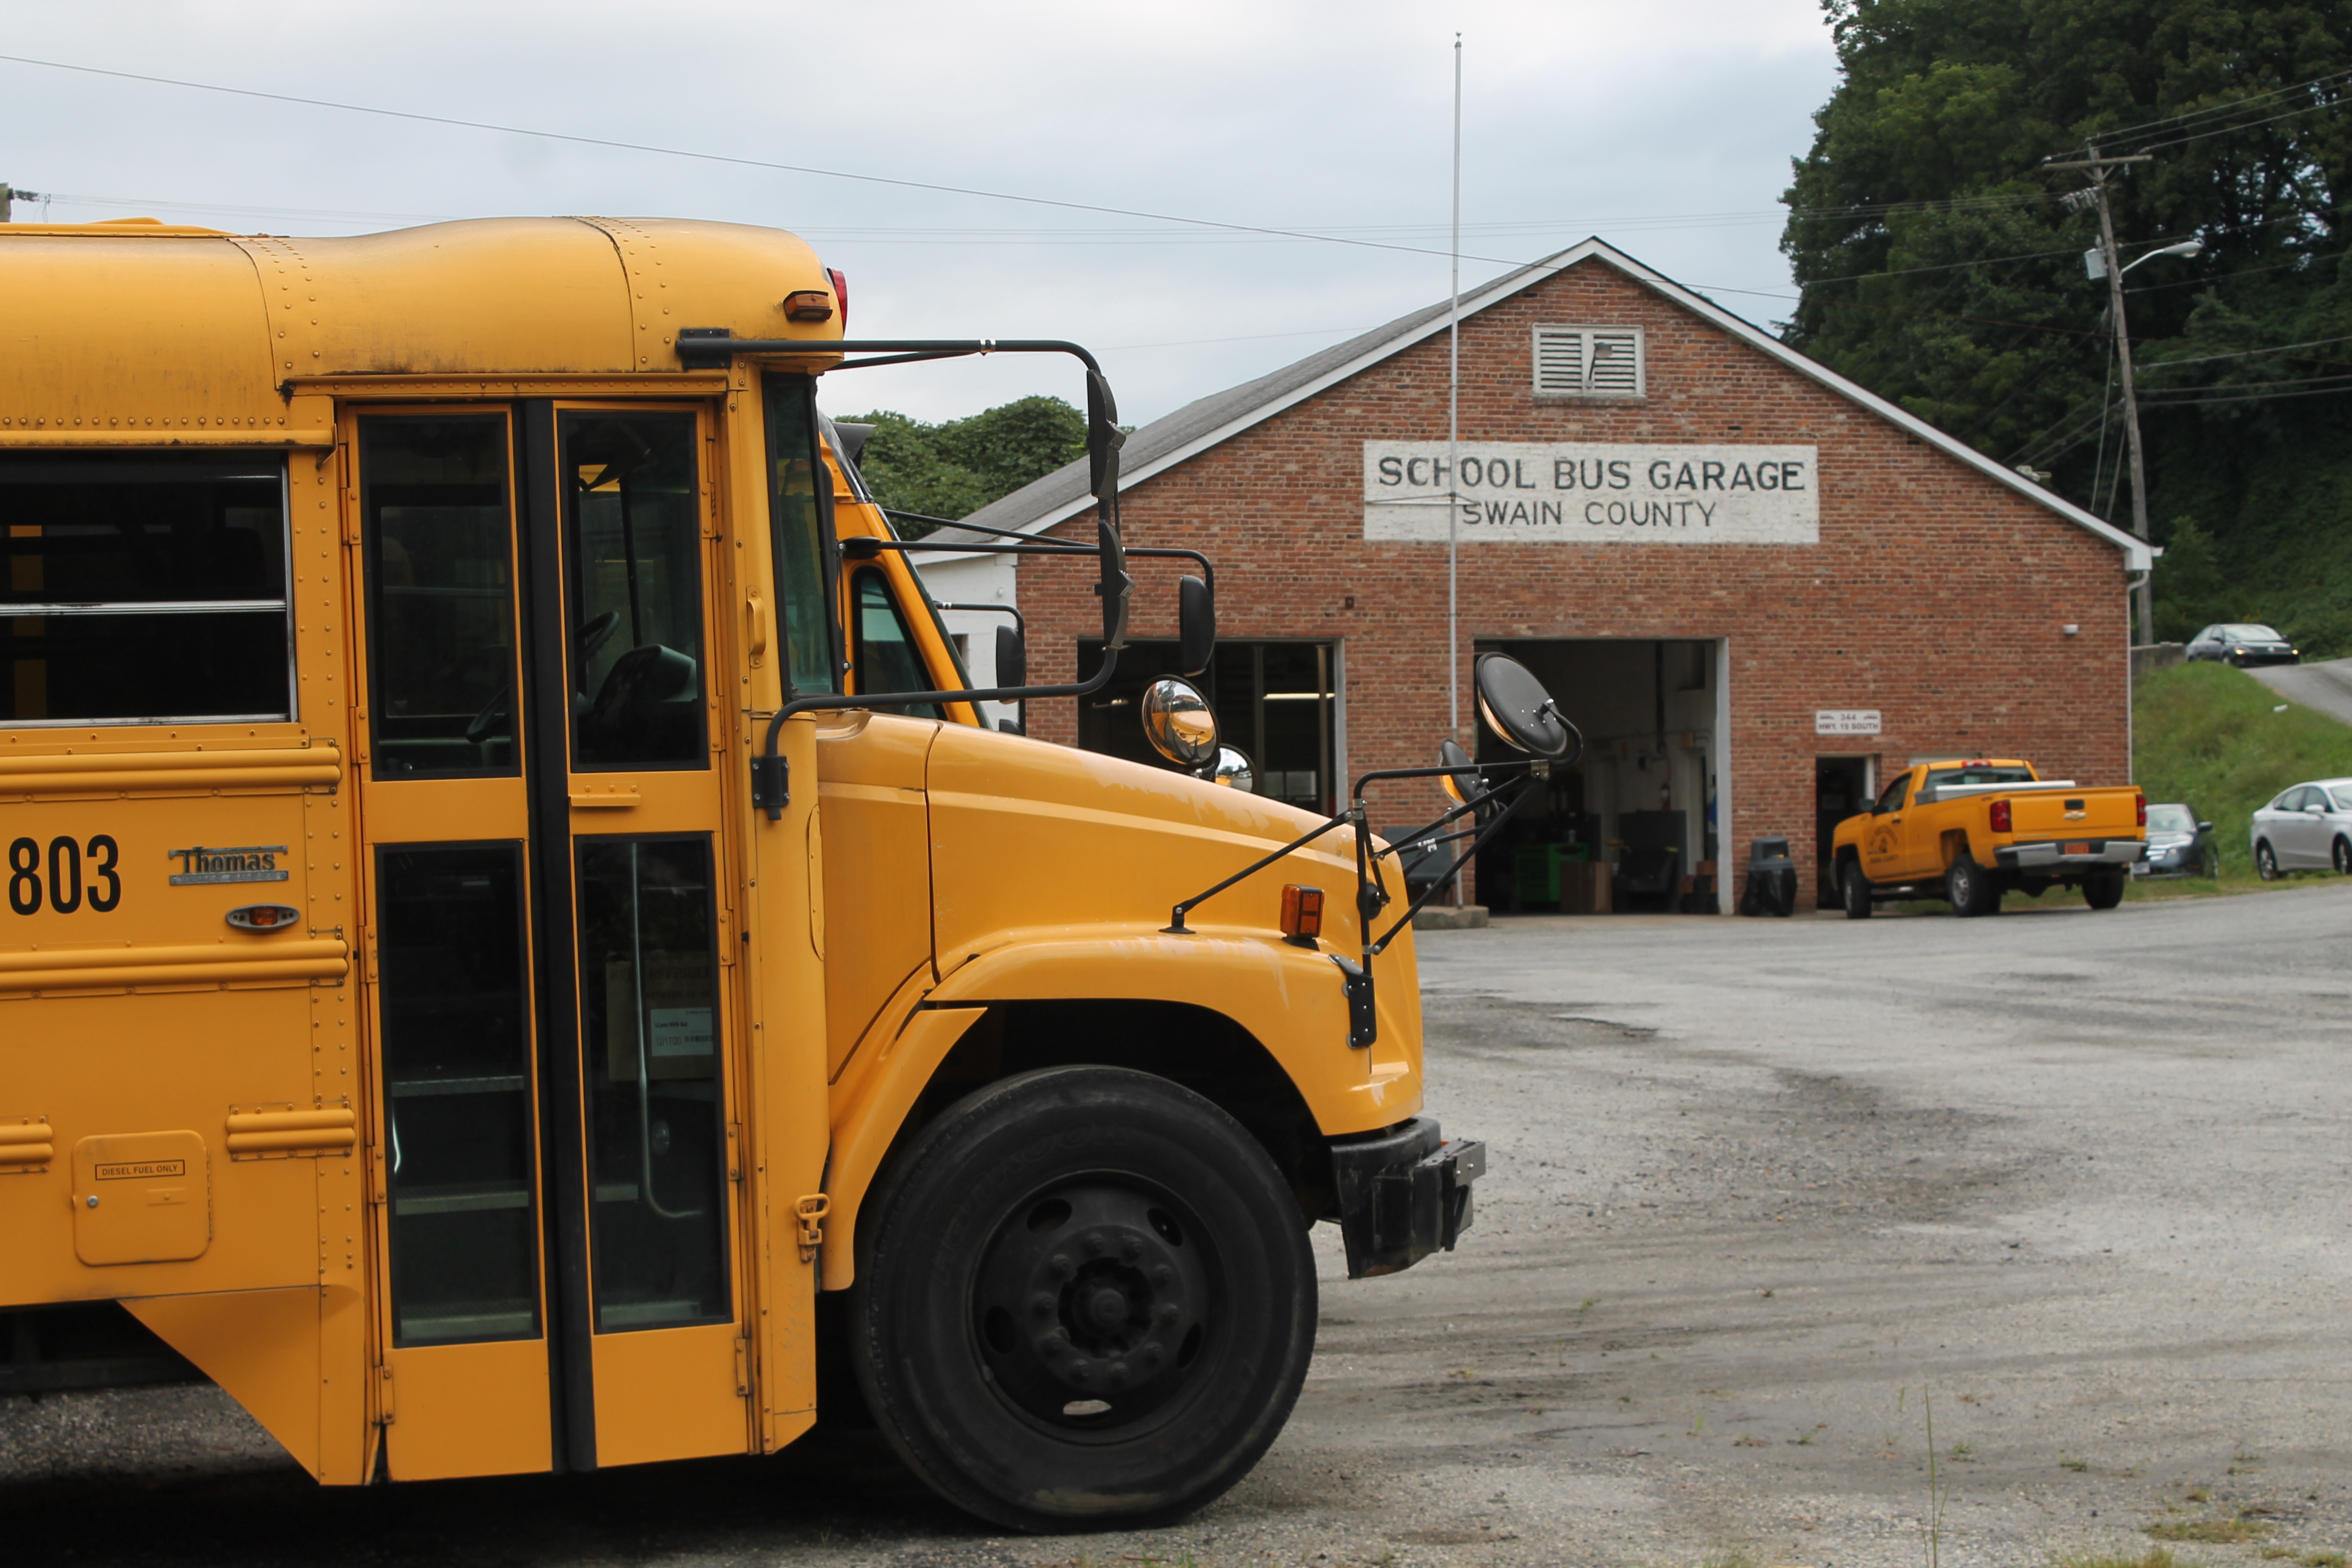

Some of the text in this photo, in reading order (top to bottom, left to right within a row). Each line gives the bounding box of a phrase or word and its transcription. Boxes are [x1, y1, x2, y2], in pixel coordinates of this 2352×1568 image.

[1379, 456, 1805, 491] SCHOOL BUS GARAGE
[1463, 500, 1716, 527] SWAIN COUNTY
[181, 846, 276, 873] Thomas
[9, 834, 121, 915] 803
[102, 1167, 131, 1175] DIESEL
